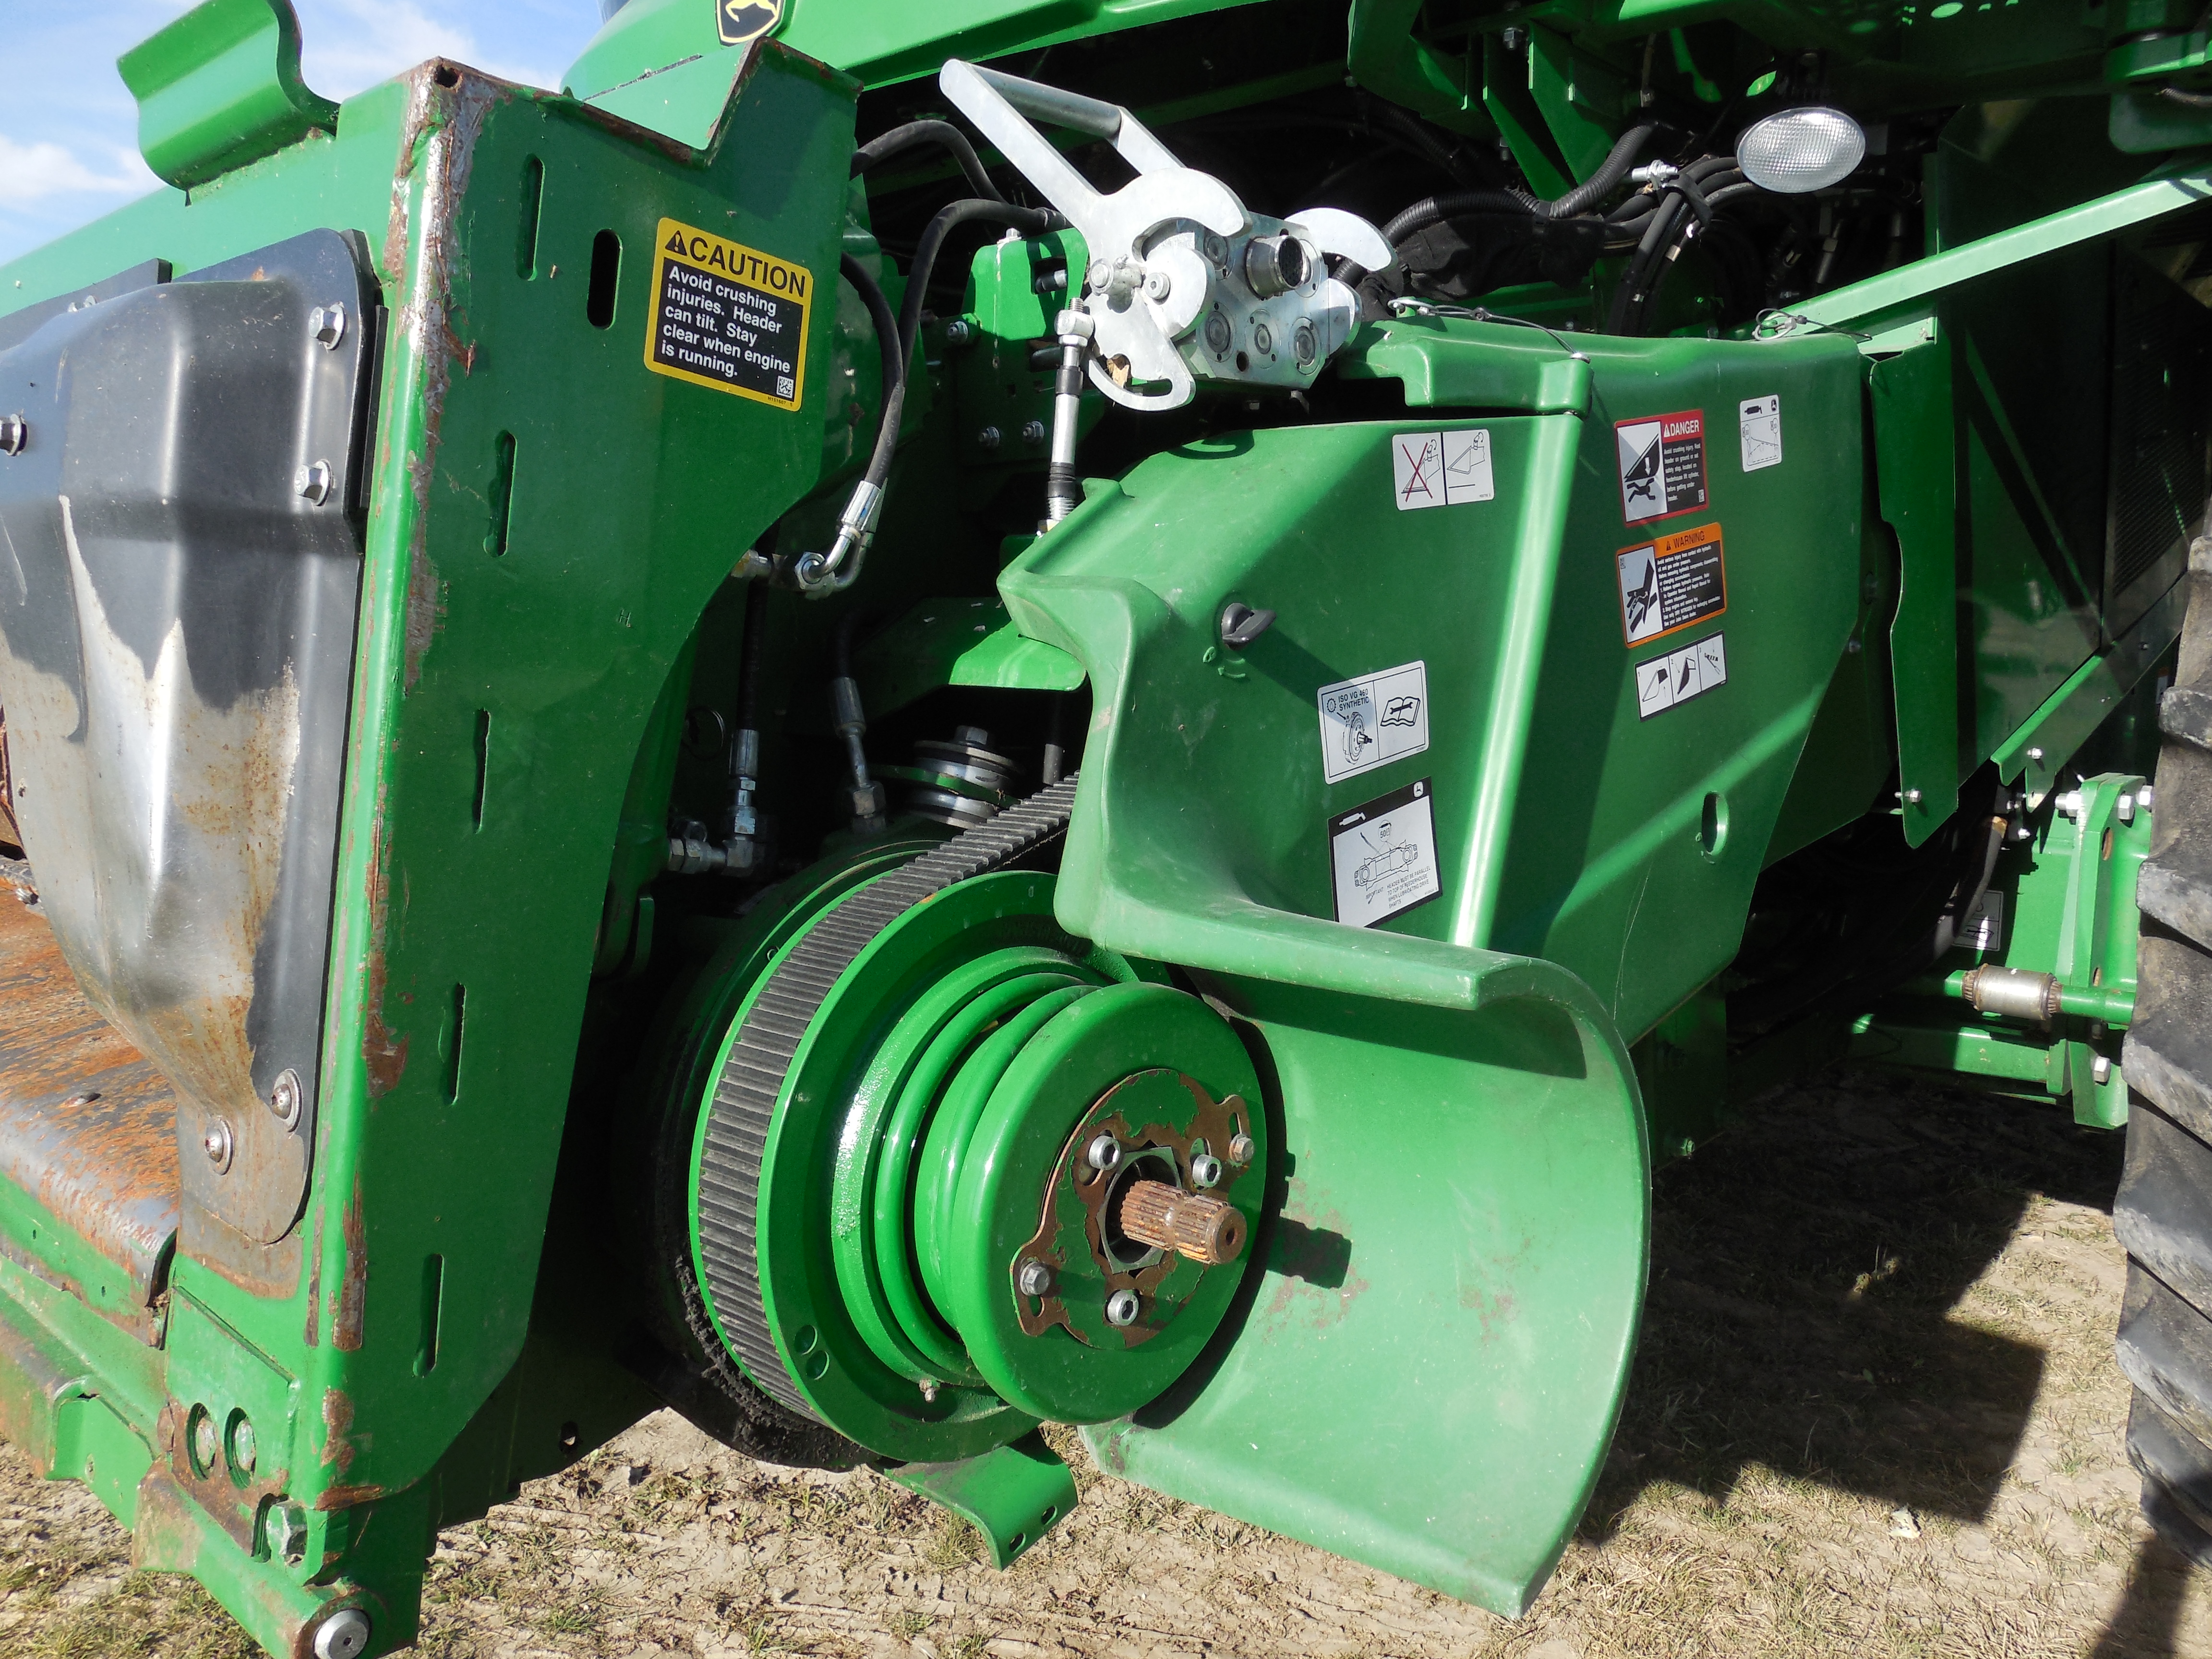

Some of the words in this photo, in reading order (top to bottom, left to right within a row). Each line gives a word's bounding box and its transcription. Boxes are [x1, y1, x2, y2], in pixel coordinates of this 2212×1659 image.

[689, 237, 805, 297] CAUTION
[667, 284, 725, 315] injuries.
[733, 306, 782, 333] Header
[669, 266, 711, 292] Avoid
[715, 284, 776, 317] crushing
[665, 306, 691, 324] can
[696, 313, 718, 332] tilt.
[726, 323, 757, 347] Stay
[661, 340, 674, 356] is
[678, 348, 737, 377] running.
[663, 325, 699, 345] clear
[703, 335, 740, 358] when
[744, 350, 790, 373] engine
[1670, 420, 1699, 436] DANGER
[1673, 531, 1705, 548] WARNING
[1338, 694, 1348, 703] ISO
[1349, 691, 1358, 699] VG
[1359, 688, 1368, 697] 460
[1339, 697, 1369, 711] SYNTHETIC
